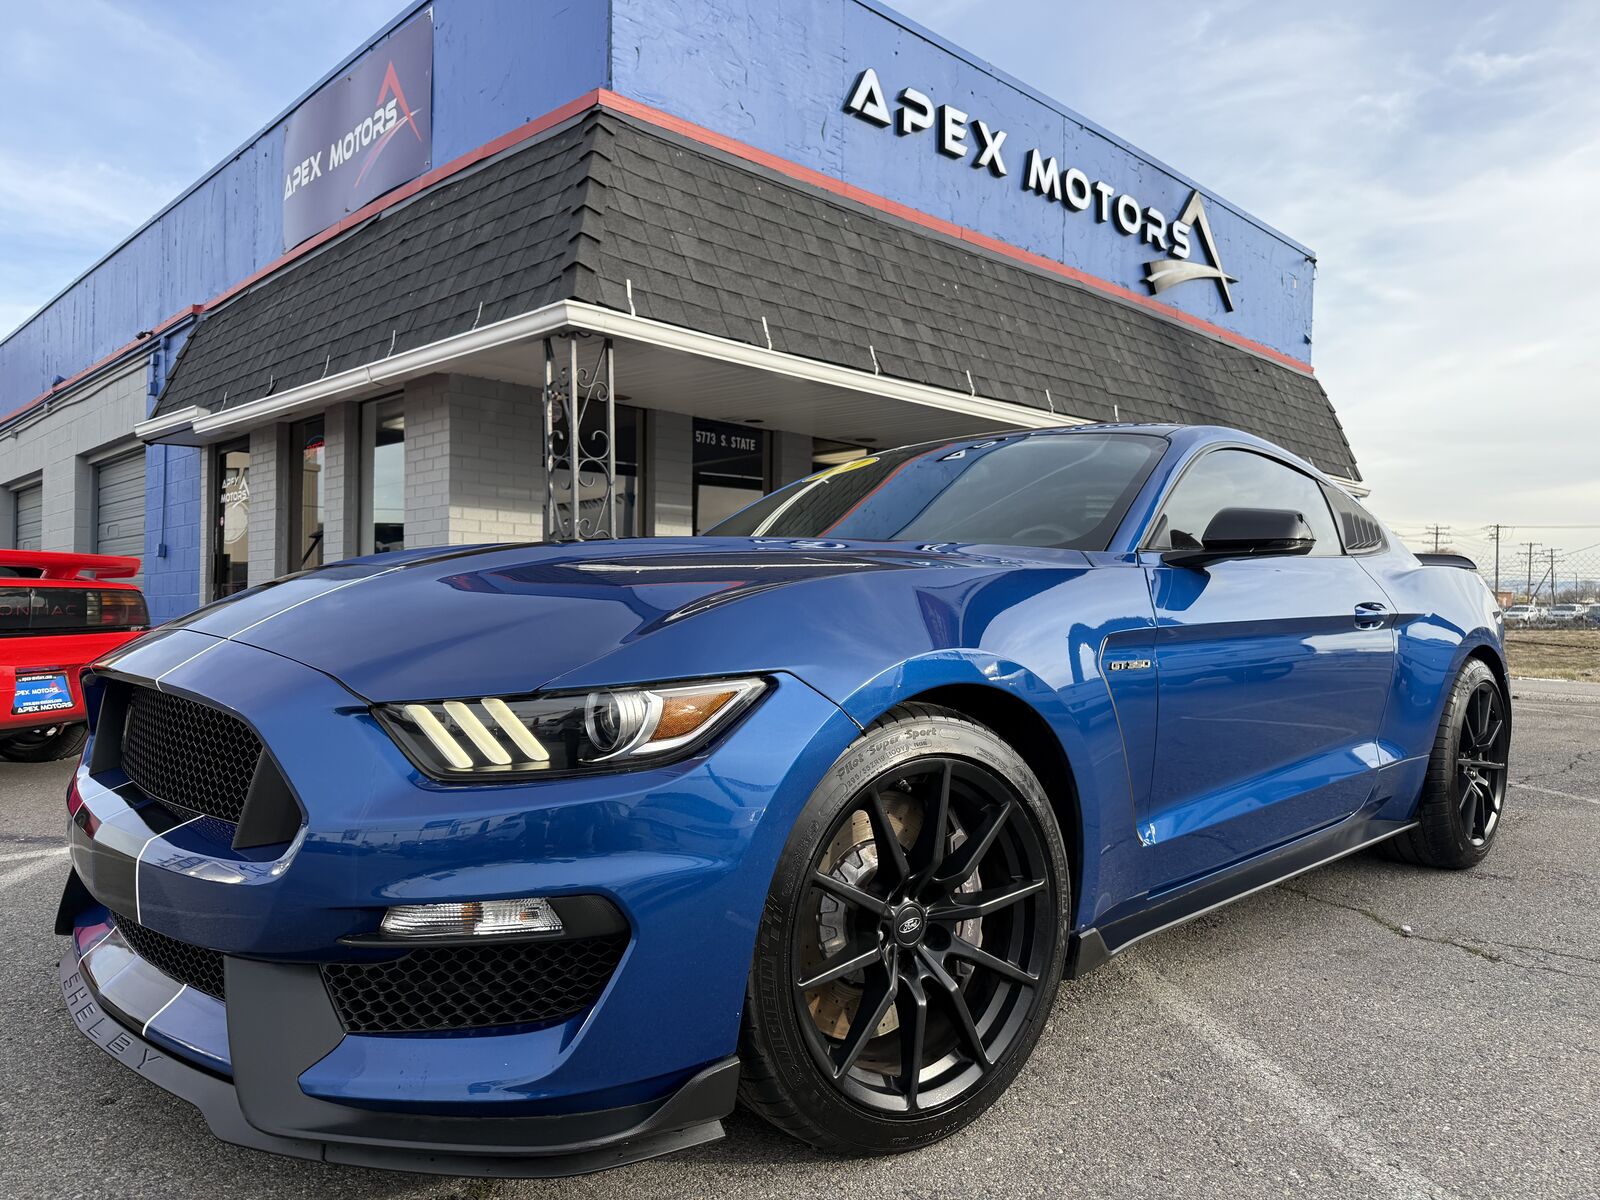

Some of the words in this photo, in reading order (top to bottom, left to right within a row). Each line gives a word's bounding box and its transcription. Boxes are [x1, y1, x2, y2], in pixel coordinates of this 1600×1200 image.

[284, 151, 322, 201] APEX
[329, 98, 397, 171] MOTORS
[847, 68, 1007, 176] APEX
[1027, 149, 1191, 259] MOTORS
[696, 430, 716, 445] 5773
[721, 434, 728, 447] S.
[731, 436, 756, 451] STATE
[220, 490, 247, 503] MOTORS
[0, 604, 77, 616] ONTIAC
[18, 705, 39, 713] APEX
[40, 701, 73, 710] MOTORS
[836, 753, 864, 780] Pilot
[867, 735, 900, 756] Super
[905, 727, 937, 740] Sport
[63, 972, 162, 1068] SHELBY
